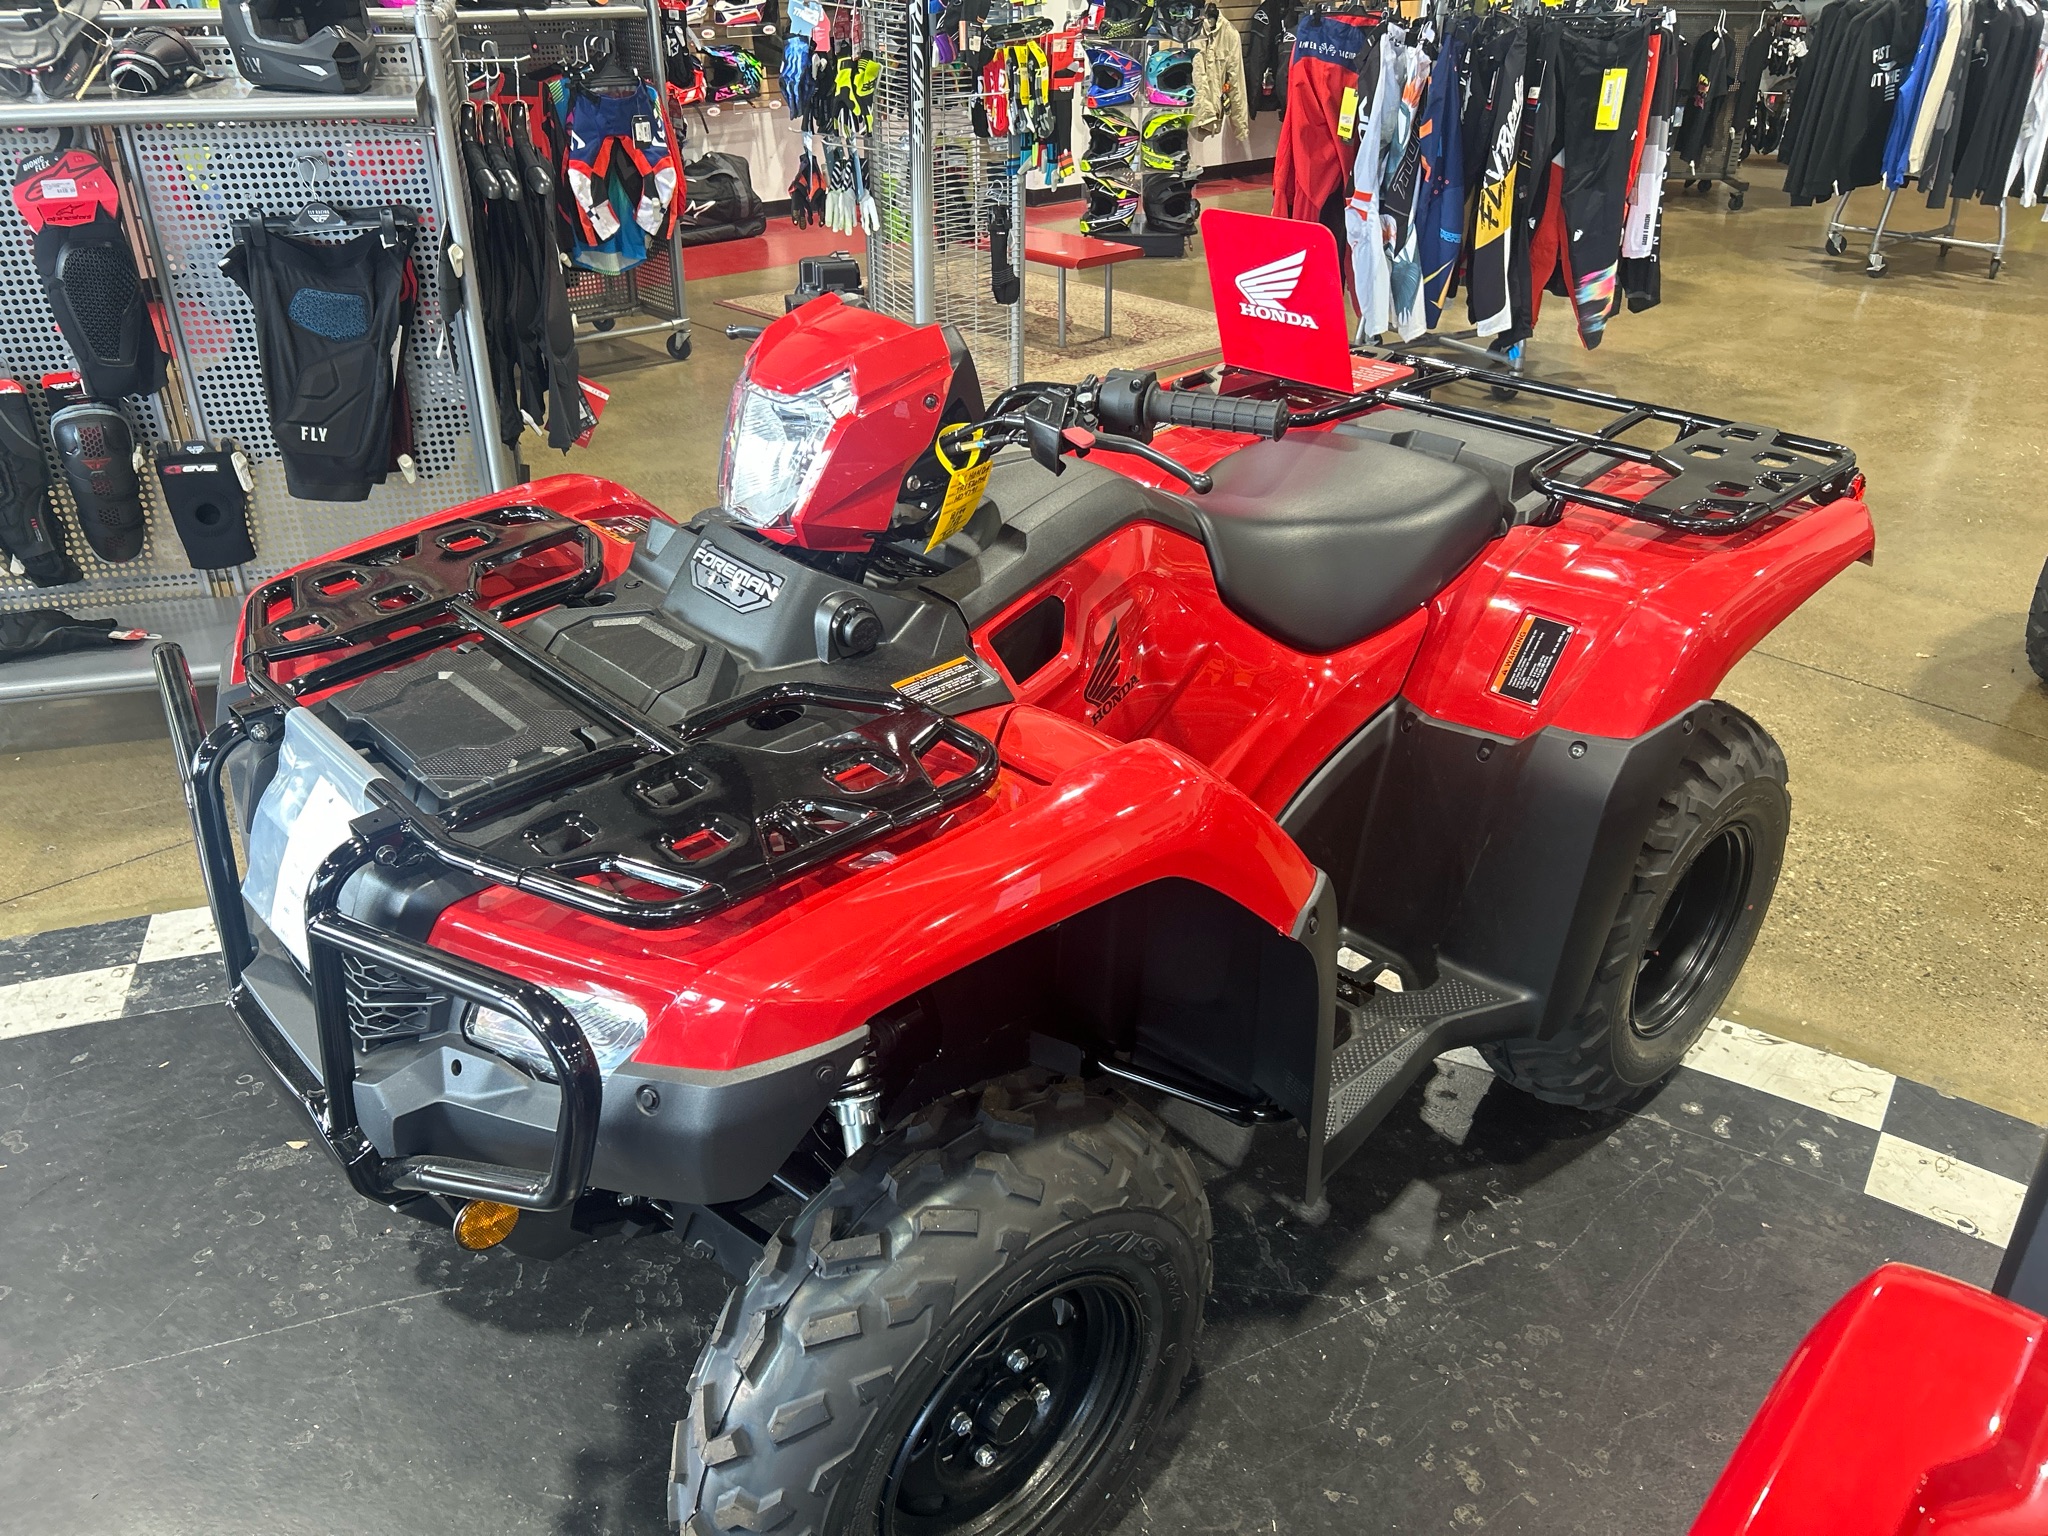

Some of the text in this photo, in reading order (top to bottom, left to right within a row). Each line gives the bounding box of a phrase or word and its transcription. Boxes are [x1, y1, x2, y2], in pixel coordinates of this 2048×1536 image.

[240, 56, 263, 74] FLY
[909, 0, 925, 152] RACING
[22, 155, 44, 172] BIONIC
[34, 160, 51, 173] FLEX
[1239, 302, 1319, 330] HONDA
[300, 426, 328, 442] FLY
[692, 547, 780, 603] FOREMAN
[1504, 630, 1527, 668] WARNING
[1090, 674, 1141, 727] HONDA
